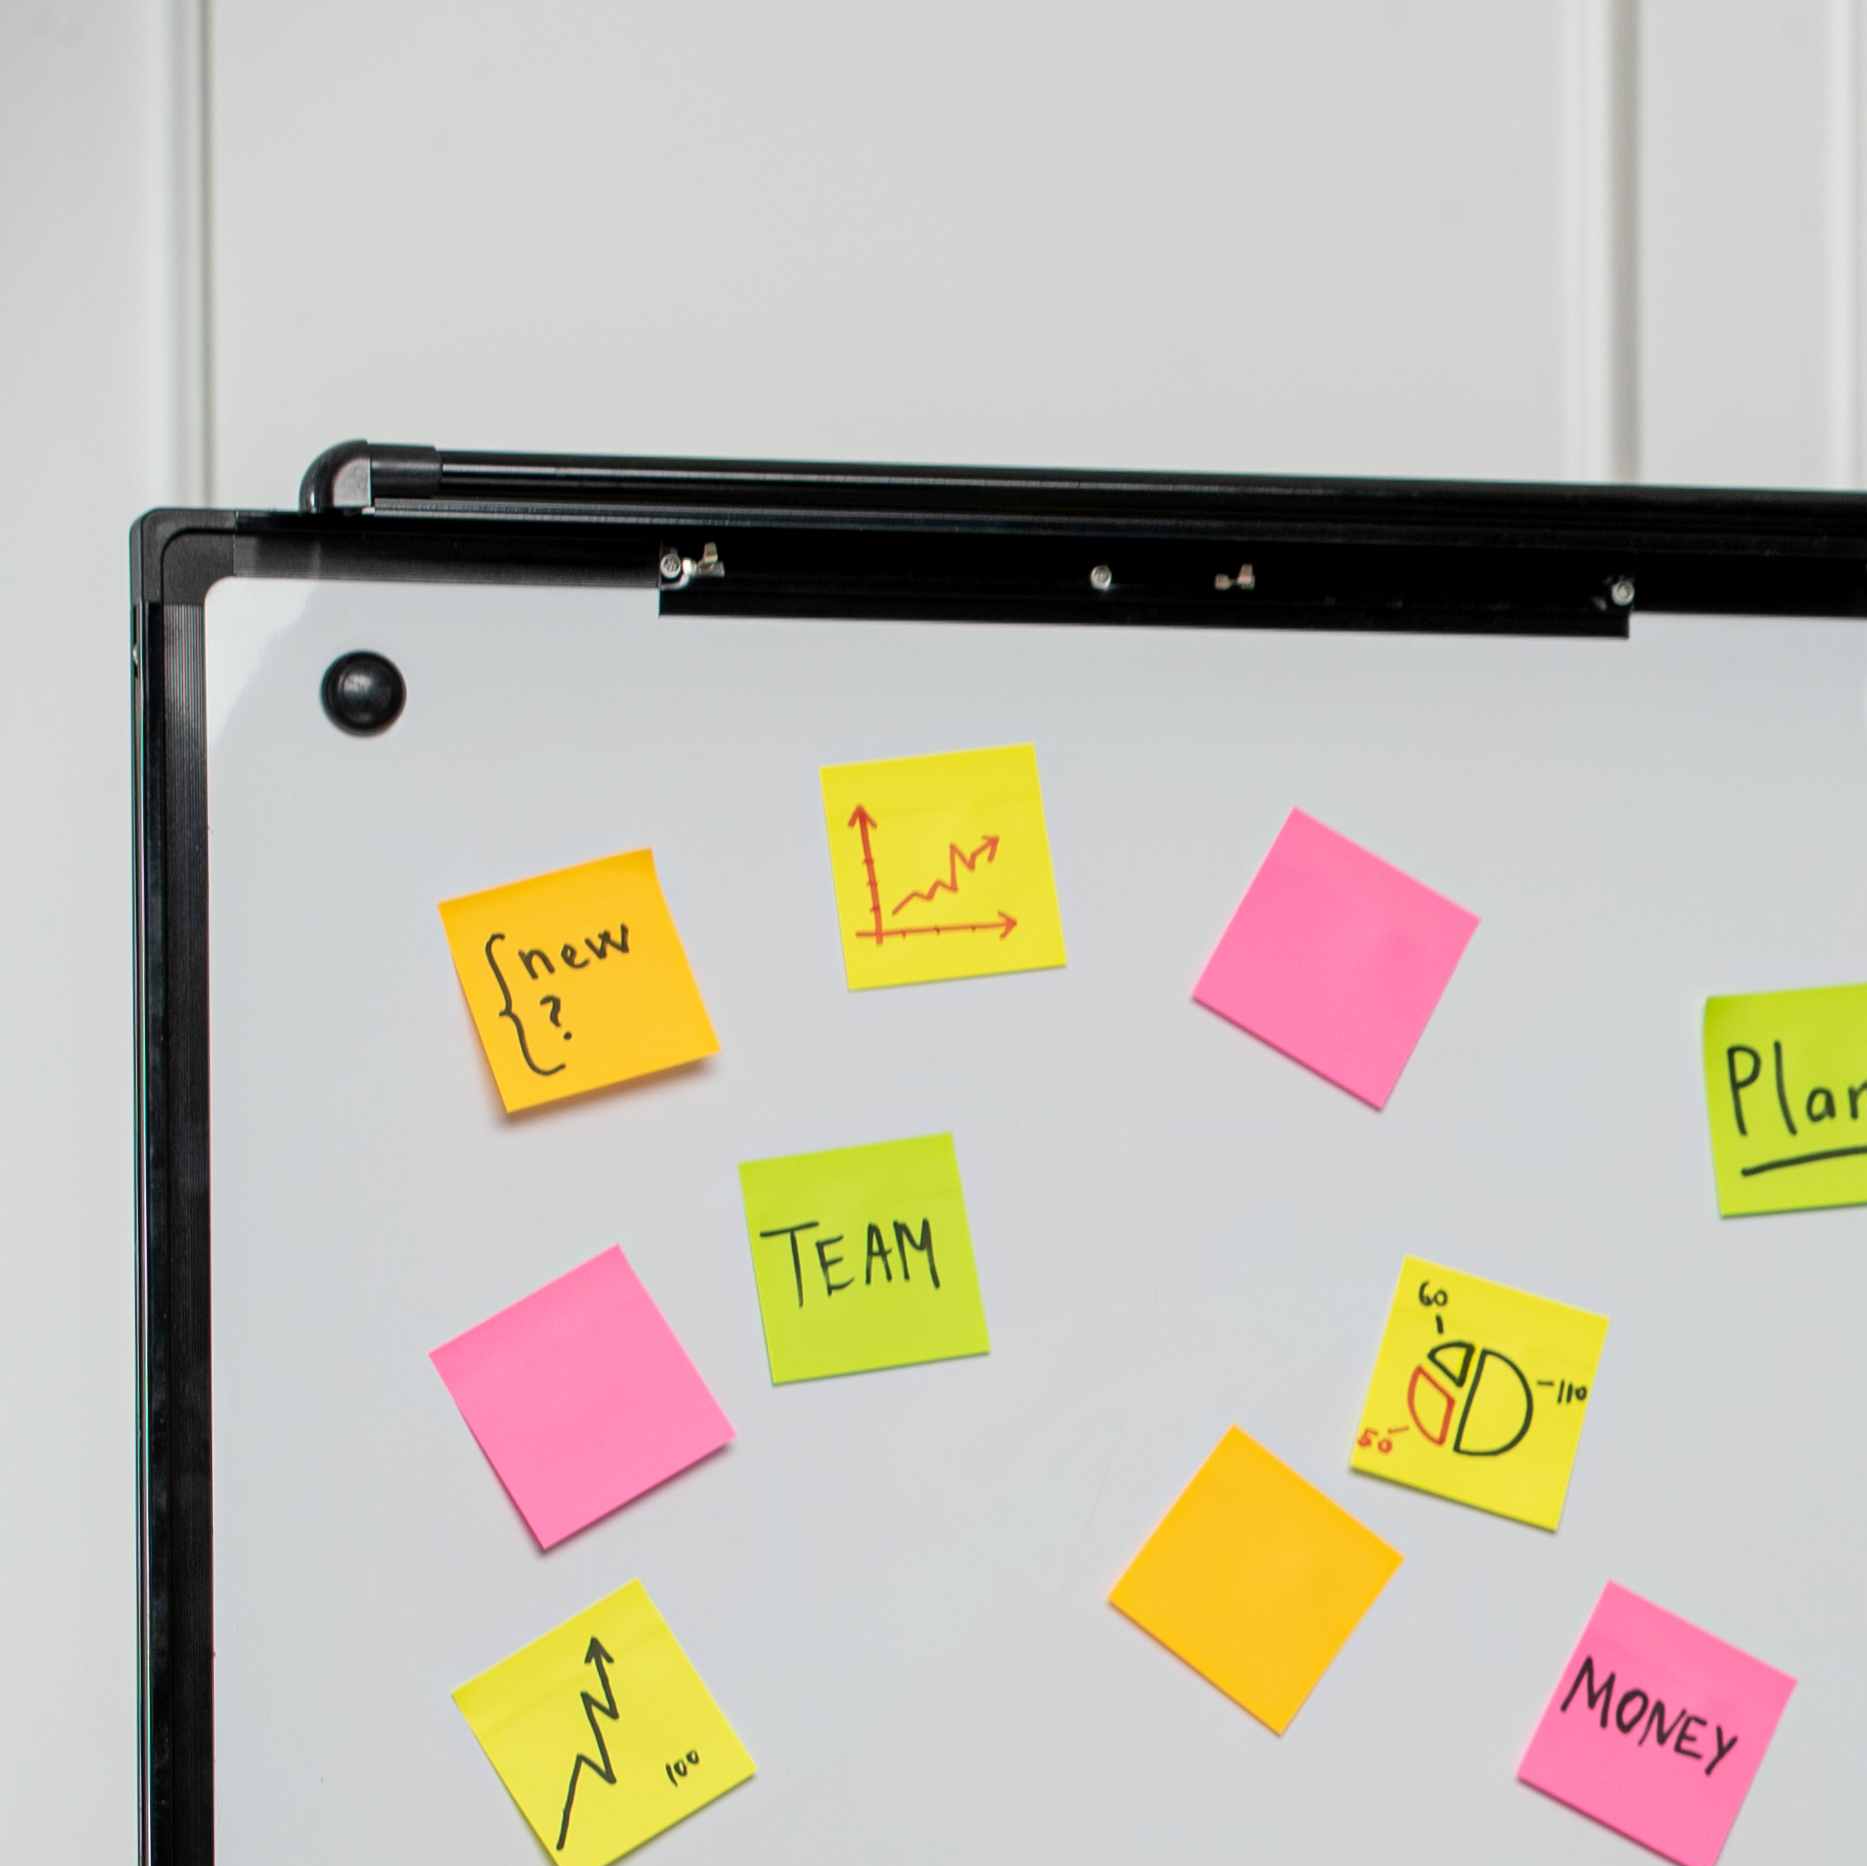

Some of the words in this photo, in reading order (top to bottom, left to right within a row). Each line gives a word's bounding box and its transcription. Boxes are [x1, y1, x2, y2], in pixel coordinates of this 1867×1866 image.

[517, 922, 630, 981] new
[539, 994, 573, 1041] ?
[759, 1216, 941, 1309] TEAM
[1417, 1280, 1449, 1308] 60
[1559, 1654, 1739, 1777] MONEY
[664, 1749, 700, 1788] 100
